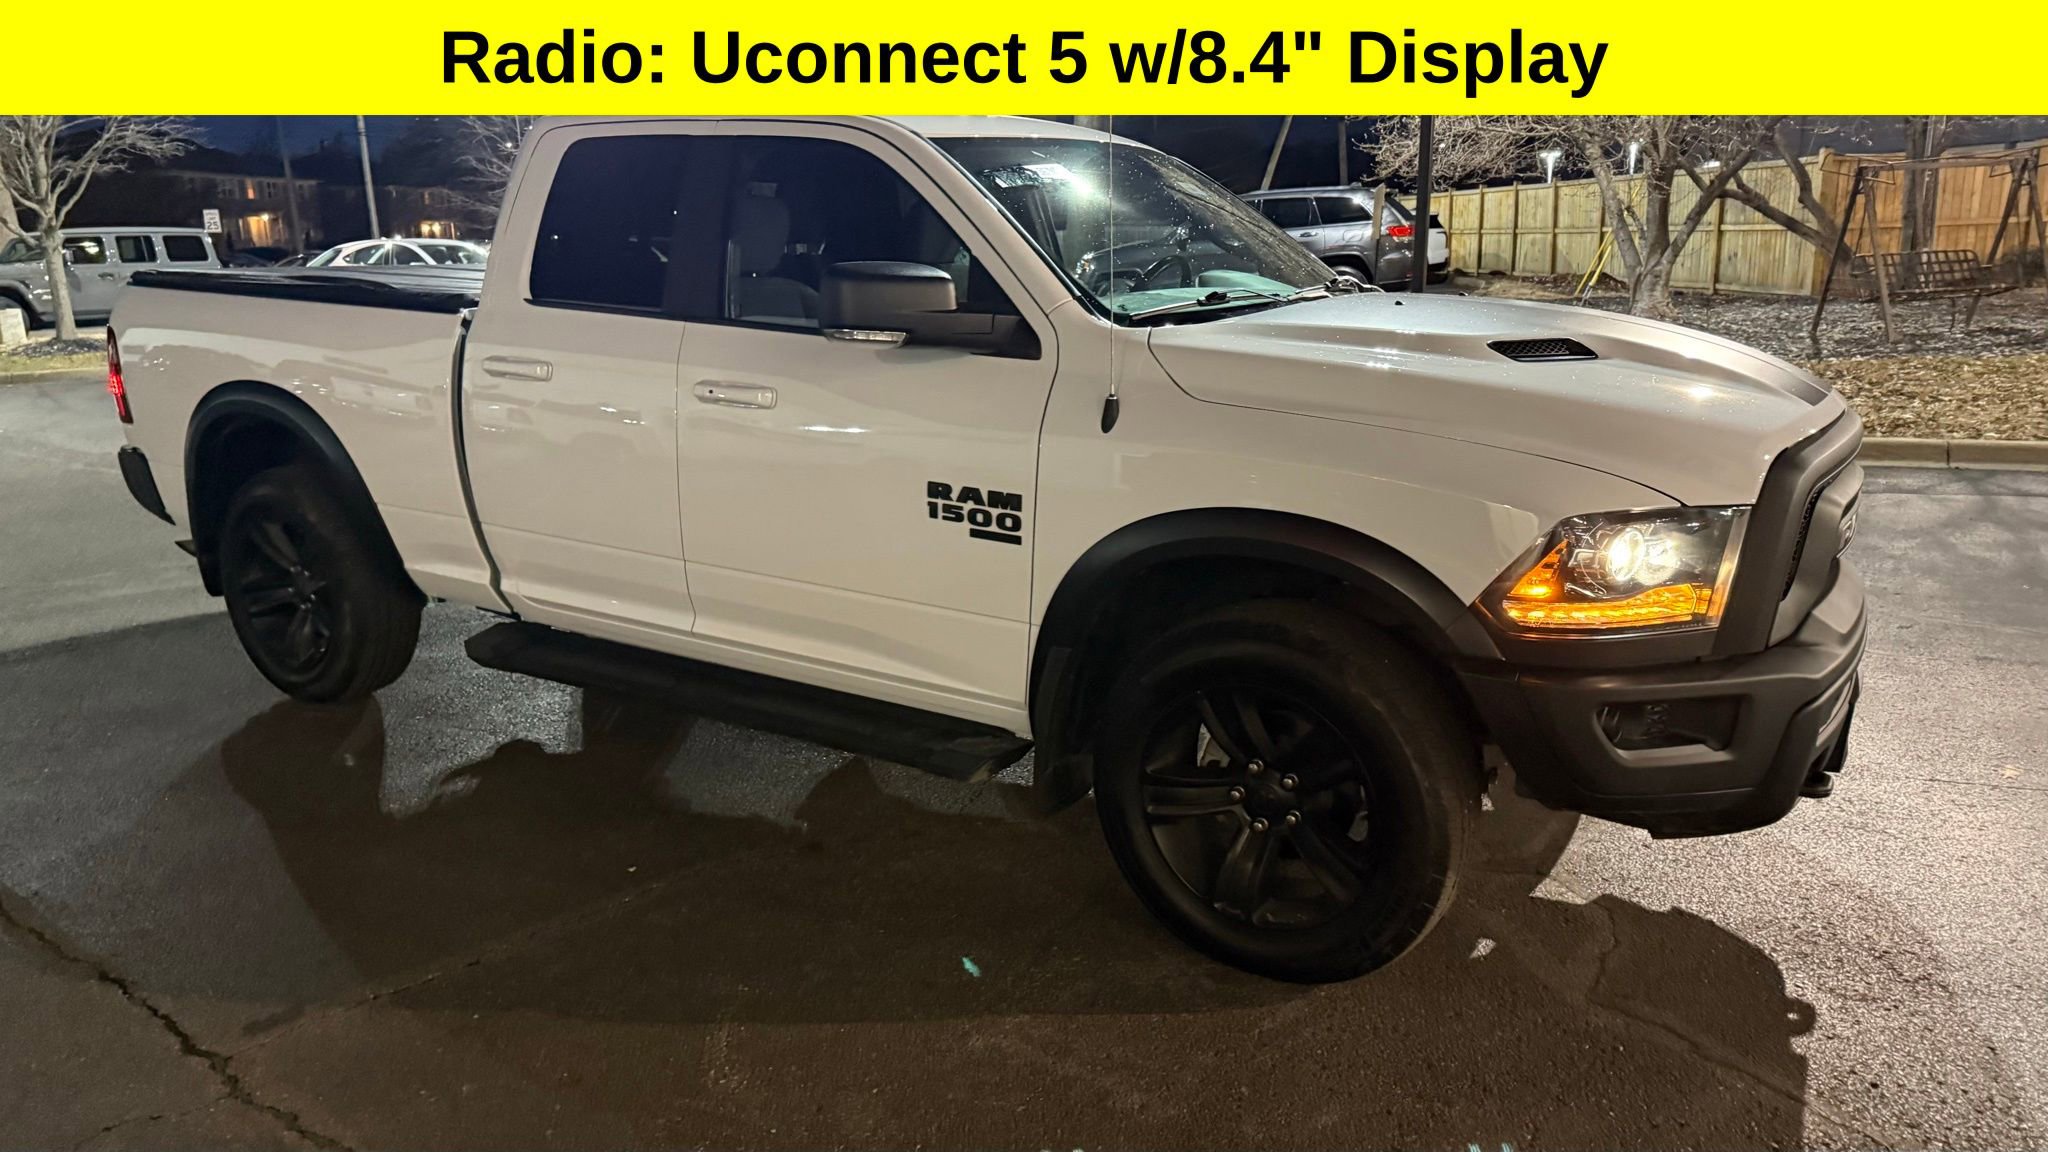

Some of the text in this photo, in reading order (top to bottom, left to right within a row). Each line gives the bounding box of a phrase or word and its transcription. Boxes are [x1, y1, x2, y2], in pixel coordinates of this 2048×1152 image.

[207, 221, 219, 230] 25
[927, 480, 1023, 513] RAM
[927, 500, 1022, 533] 1500
